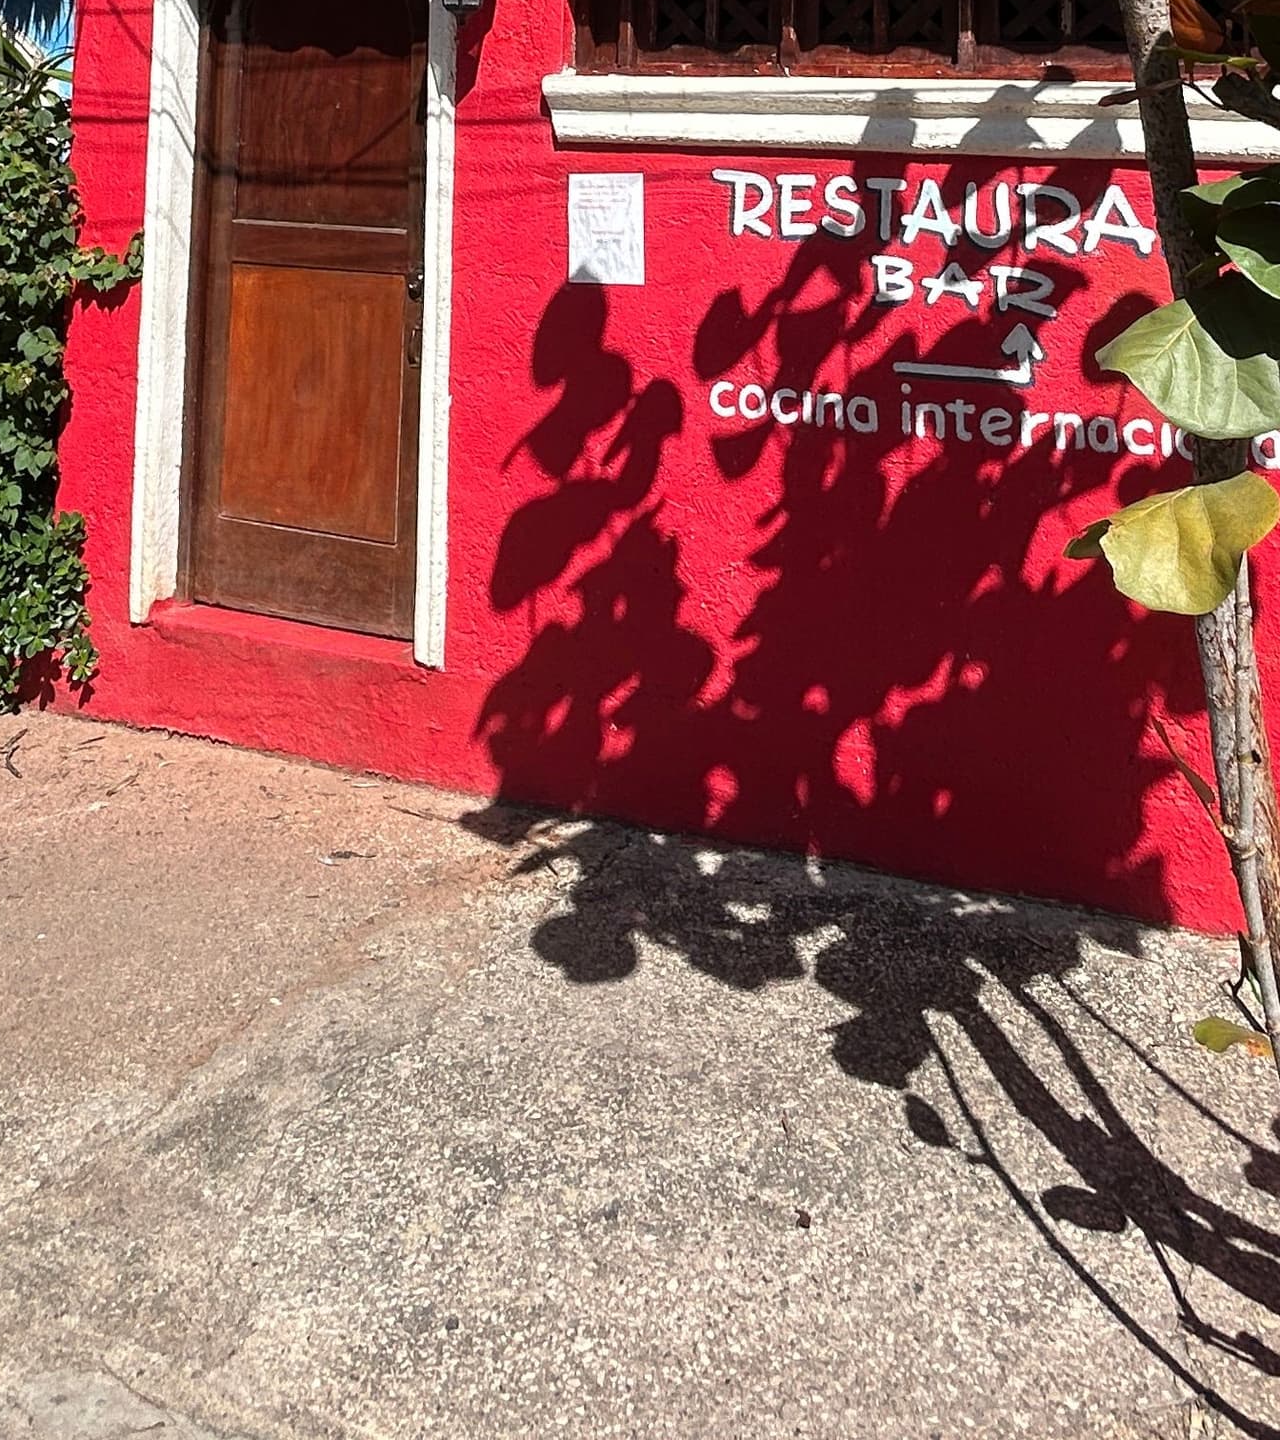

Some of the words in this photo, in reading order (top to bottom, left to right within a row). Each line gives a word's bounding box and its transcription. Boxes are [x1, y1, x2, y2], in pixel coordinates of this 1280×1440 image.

[713, 168, 1155, 255] RESTAURA
[871, 255, 1057, 318] BAR
[710, 380, 878, 433] cocina
